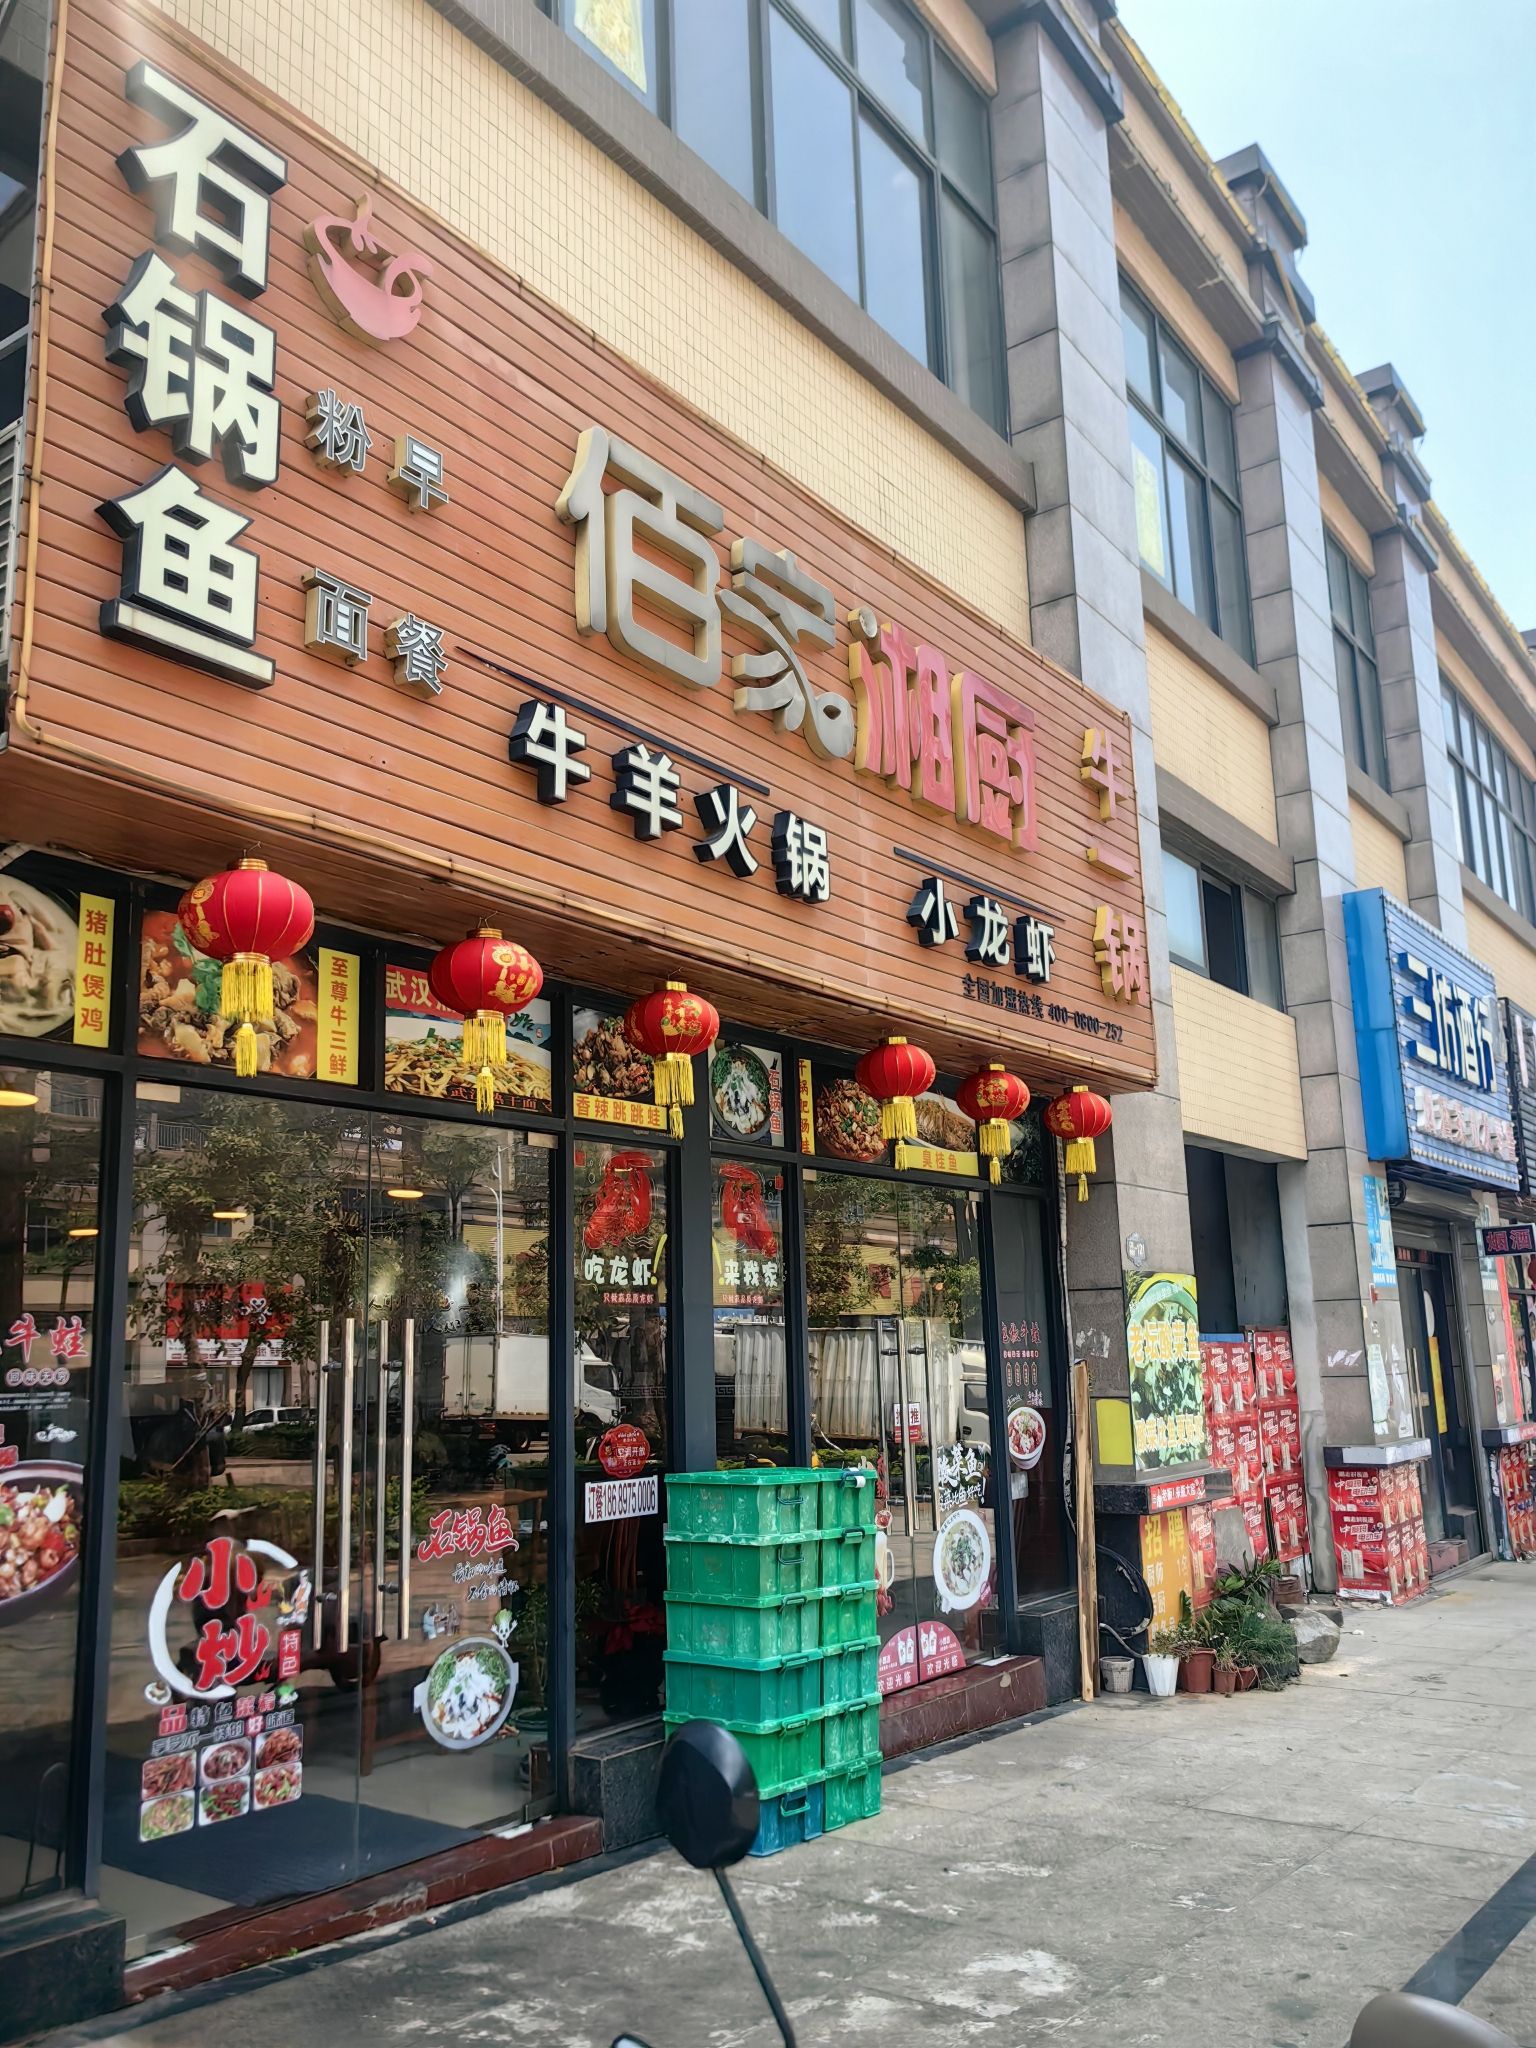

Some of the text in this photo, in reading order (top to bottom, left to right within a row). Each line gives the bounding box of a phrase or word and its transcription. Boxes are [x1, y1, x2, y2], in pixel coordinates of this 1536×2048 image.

[94, 58, 289, 690] 石锅鱼
[509, 699, 832, 903] 牛羊火锅
[908, 877, 1056, 984] 小龙虾
[80, 908, 108, 1033] 猪肚煲鸡
[961, 973, 1044, 1019] 全国加盟热线
[328, 956, 349, 1077] 至尊牛三鲜
[576, 1095, 661, 1128] 香辣跳跳蛙
[768, 1067, 783, 1136] 石锅鱼
[922, 1149, 958, 1172] 臭桂鱼
[1486, 1229, 1532, 1252] 烟酒
[1128, 1317, 1200, 1367] 老坛酸菜鱼
[418, 1504, 519, 1562] 石锅鱼
[1144, 1509, 1185, 1560] 招聘
[180, 1537, 269, 1690] 小炒
[281, 1632, 299, 1676] 特色
[927, 1654, 959, 1677] 欢迎光临
[877, 1670, 912, 1693] 欢迎光临
